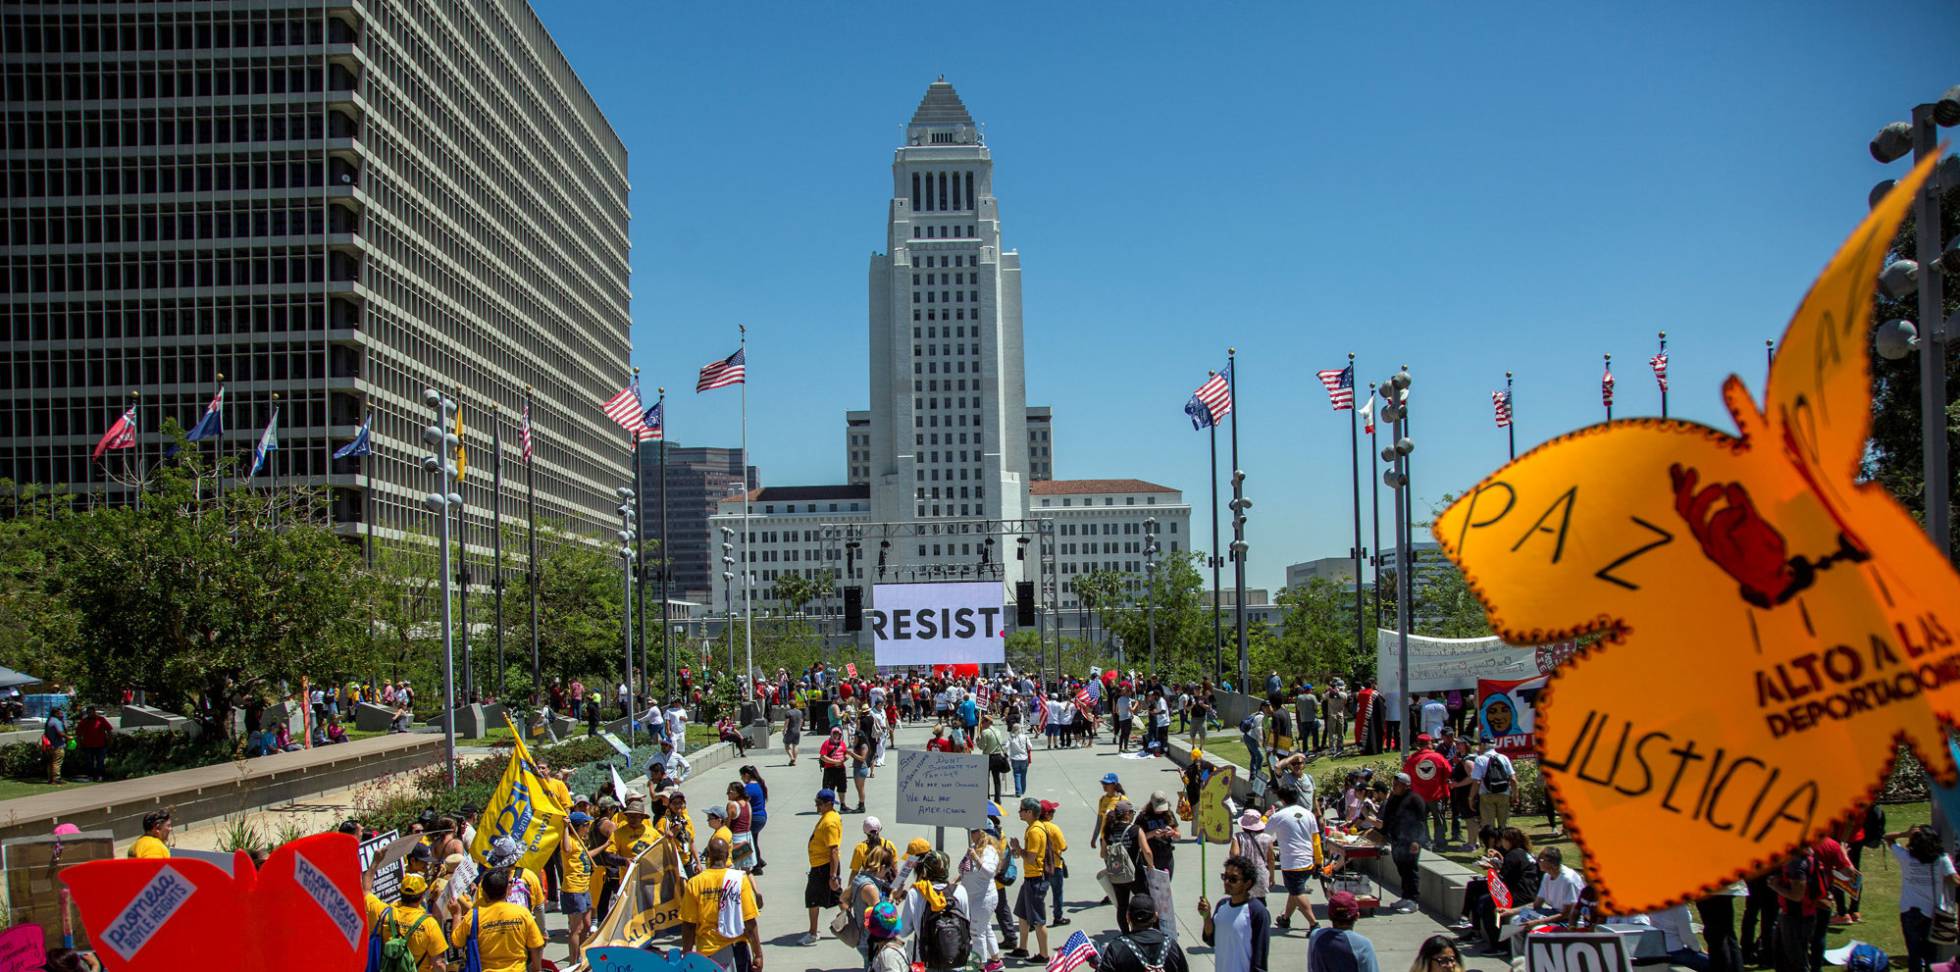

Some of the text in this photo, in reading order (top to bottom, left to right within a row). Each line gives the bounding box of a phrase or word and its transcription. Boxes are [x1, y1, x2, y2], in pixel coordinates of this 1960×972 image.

[1457, 480, 1675, 591] PAZ
[1753, 644, 1865, 708] ALTO
[1869, 633, 1900, 671] A
[1494, 734, 1527, 749] UFW
[108, 874, 175, 950] promesa
[124, 883, 188, 951] BOYLE HEIGHTS
[299, 858, 360, 931] promesa
